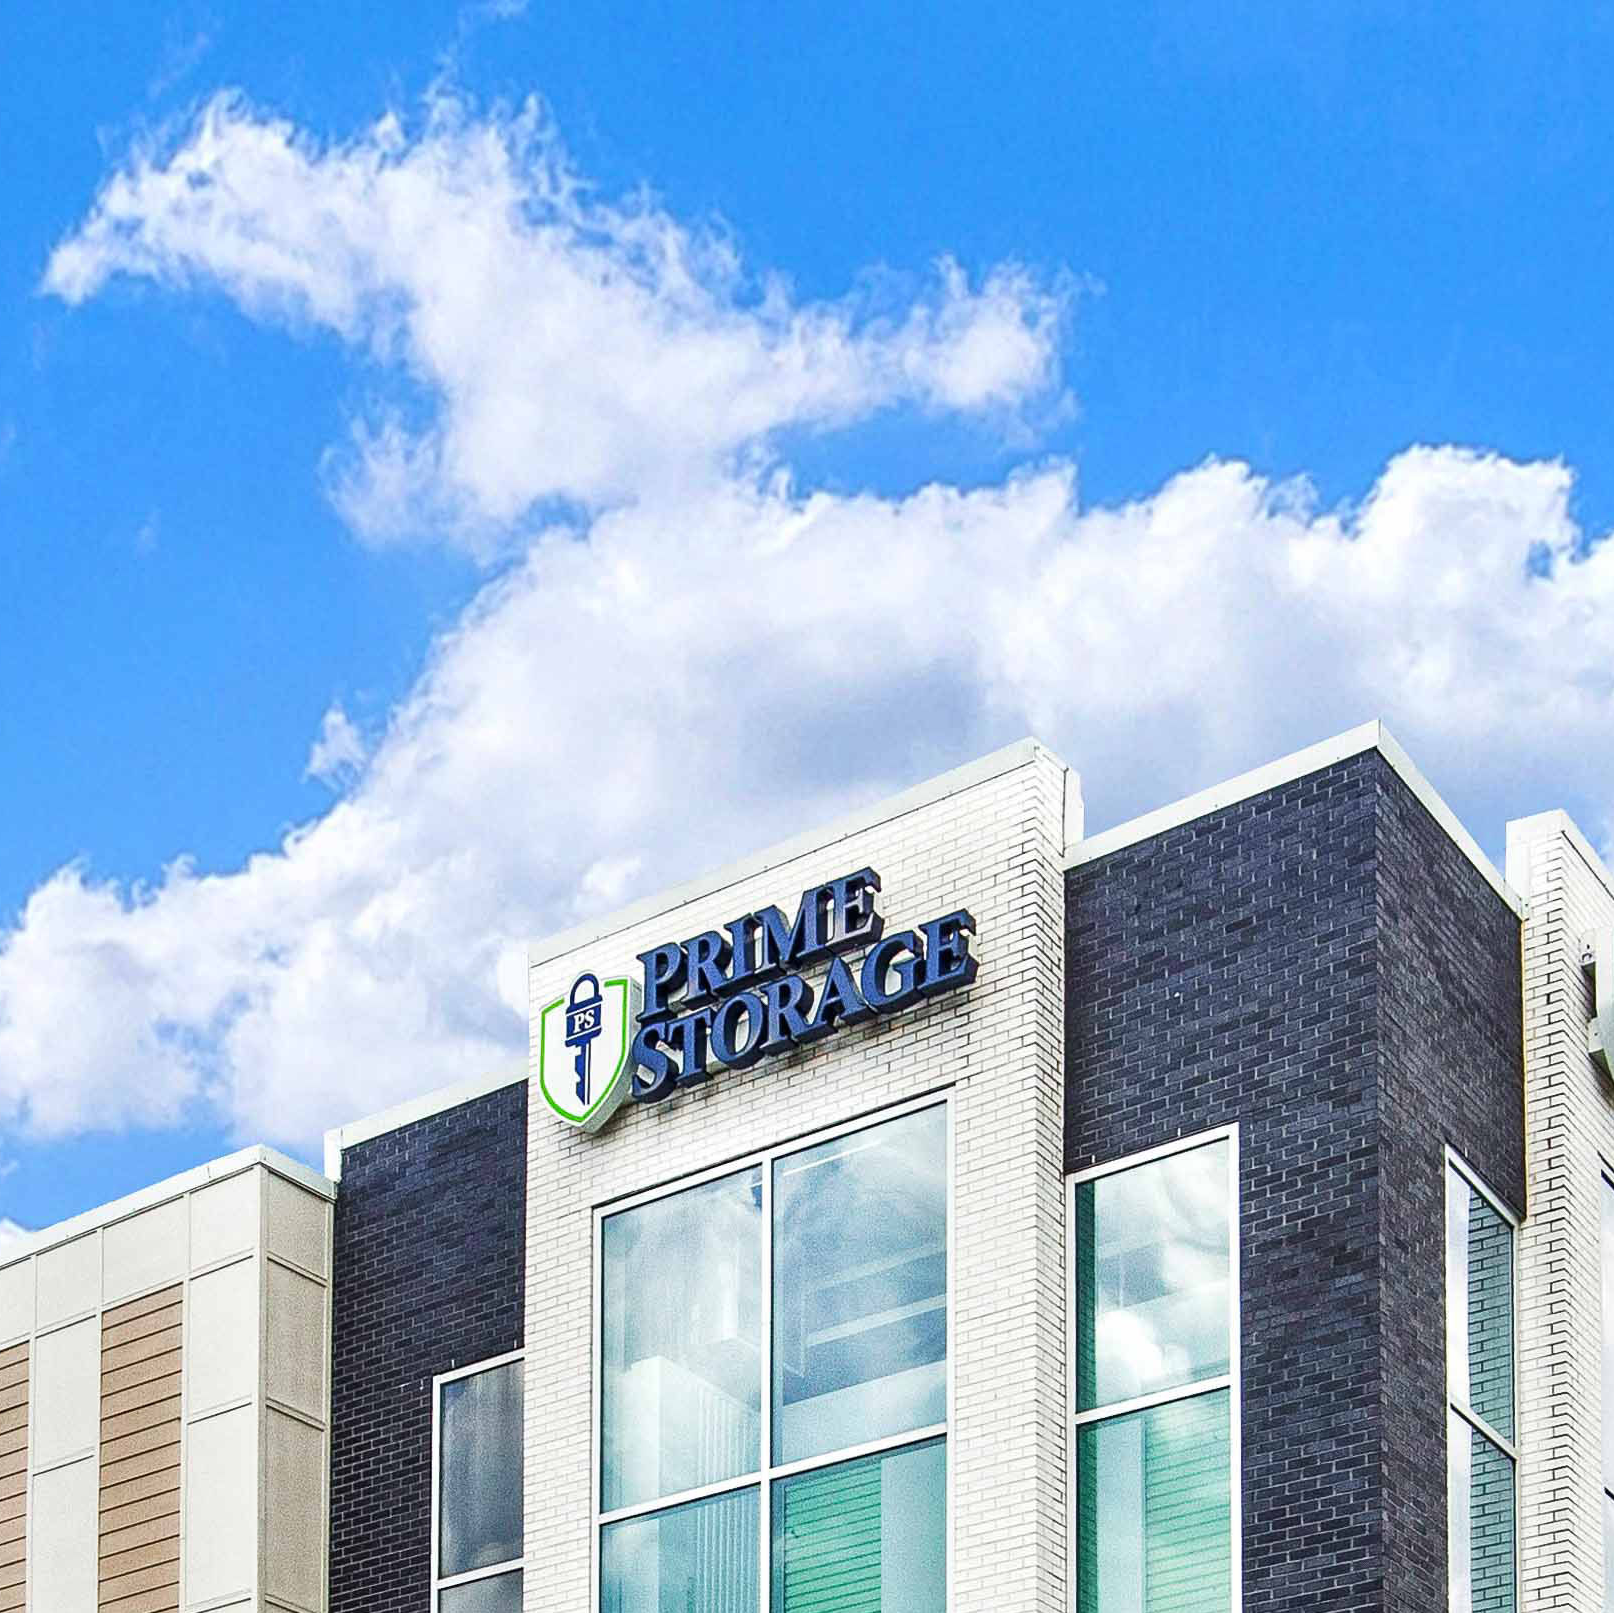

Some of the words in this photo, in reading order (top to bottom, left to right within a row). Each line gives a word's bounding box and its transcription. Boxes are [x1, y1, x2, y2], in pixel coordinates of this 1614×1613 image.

[573, 1009, 595, 1034] PS
[630, 908, 980, 1102] STORAGE
[636, 866, 884, 1023] PRIME
